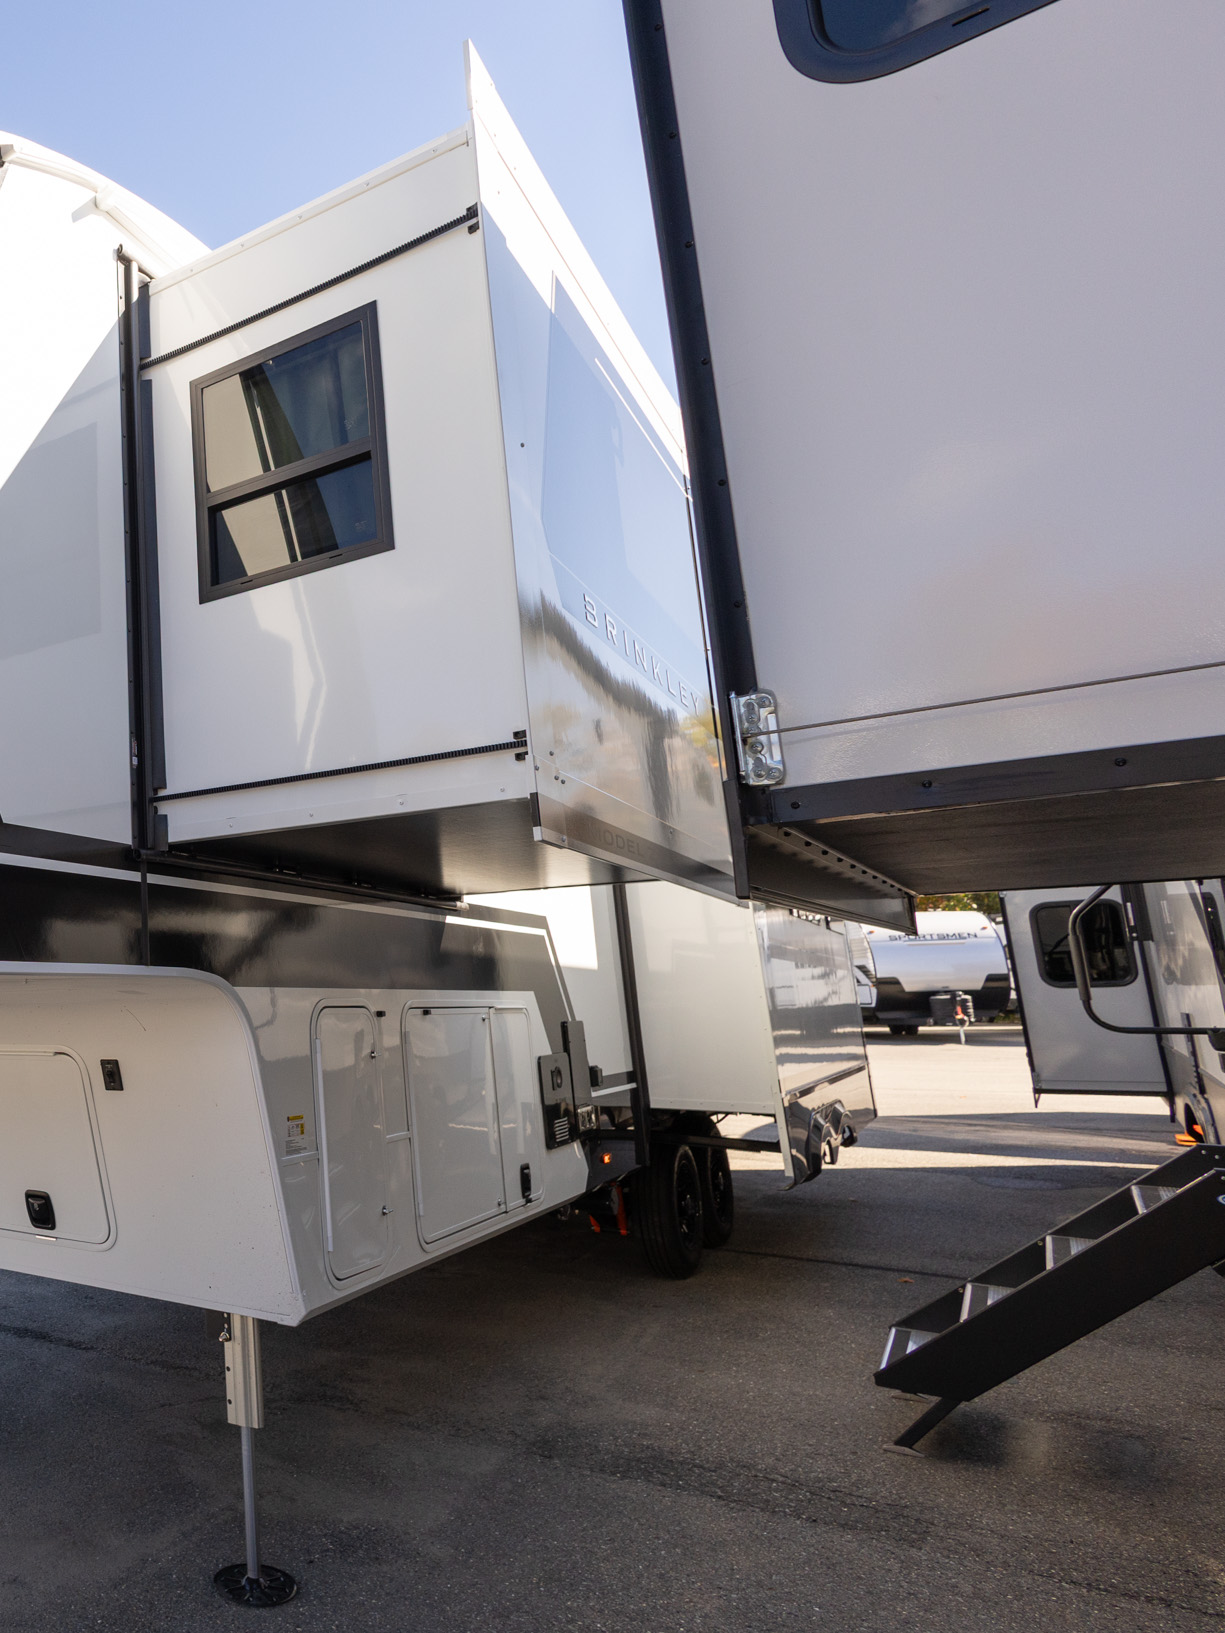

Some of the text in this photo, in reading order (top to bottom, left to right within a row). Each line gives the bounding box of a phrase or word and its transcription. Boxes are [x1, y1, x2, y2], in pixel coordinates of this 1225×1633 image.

[583, 593, 699, 717] BRINKLEY
[587, 822, 645, 857] MODEL
[888, 932, 978, 942] SPORTSMEN
